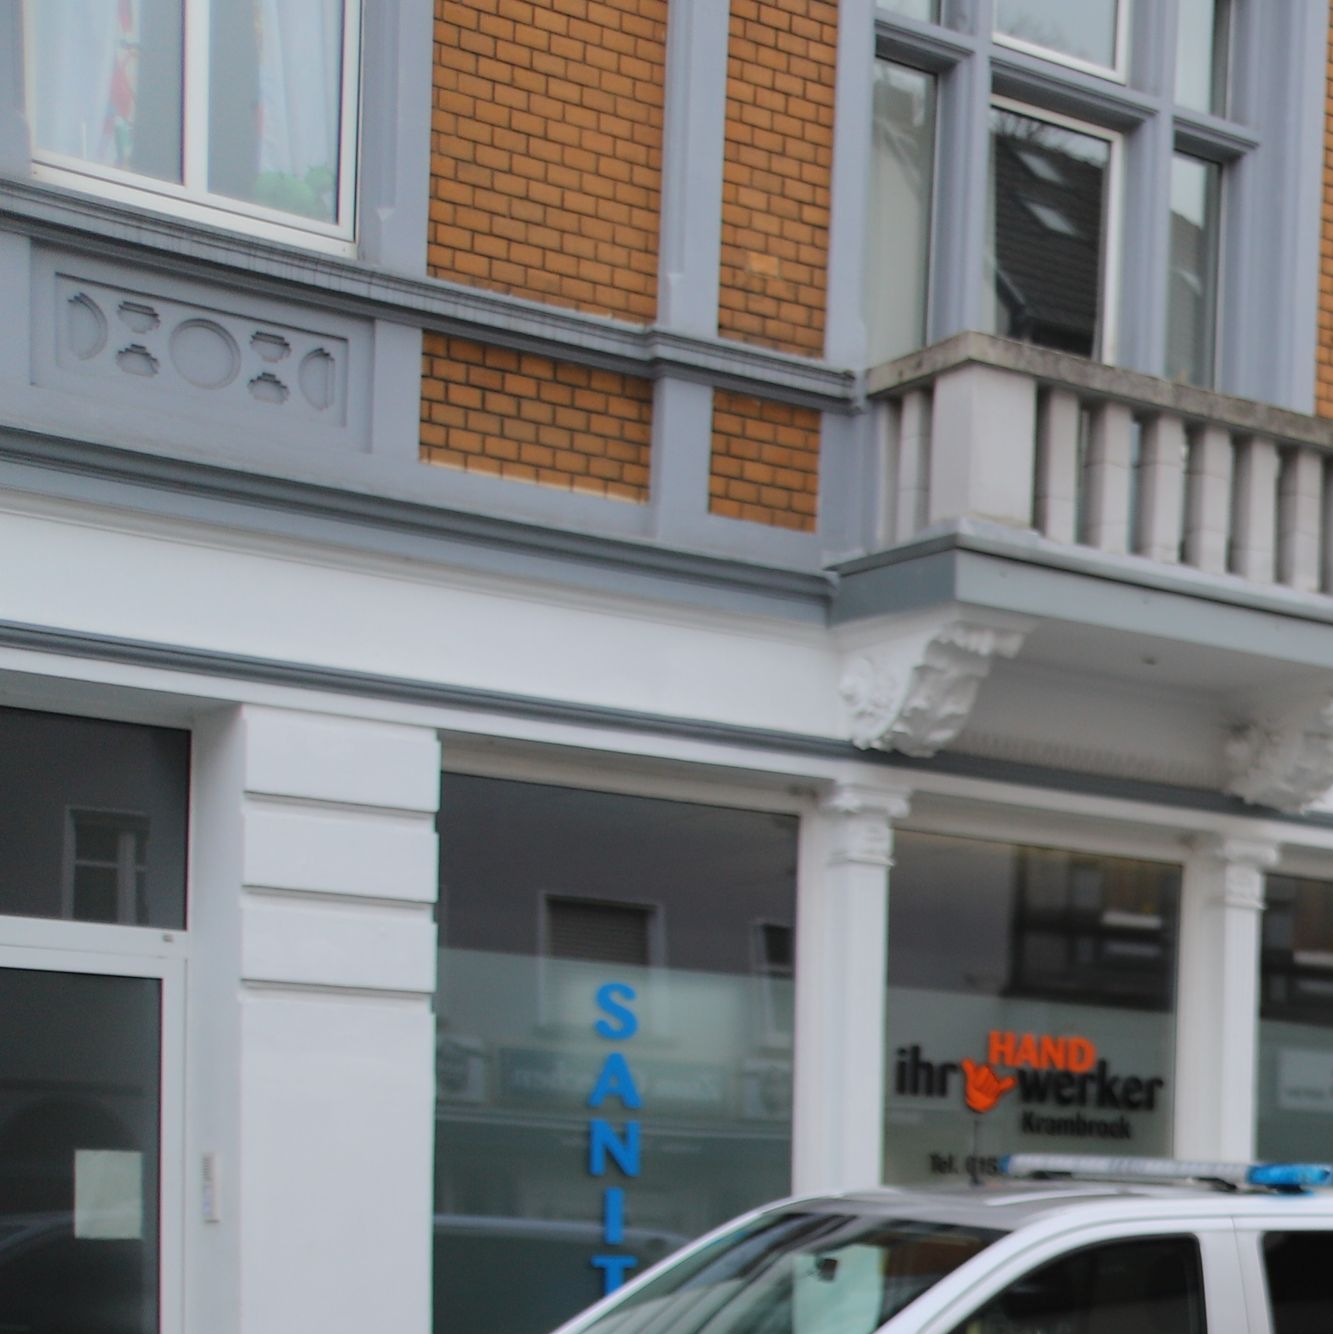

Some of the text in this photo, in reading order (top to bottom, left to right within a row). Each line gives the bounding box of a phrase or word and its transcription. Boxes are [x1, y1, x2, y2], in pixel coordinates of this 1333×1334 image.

[896, 1045, 958, 1097] ihr
[988, 1031, 1096, 1073] HAND
[1017, 1058, 1164, 1112] werker
[588, 982, 642, 1296] SANIT
